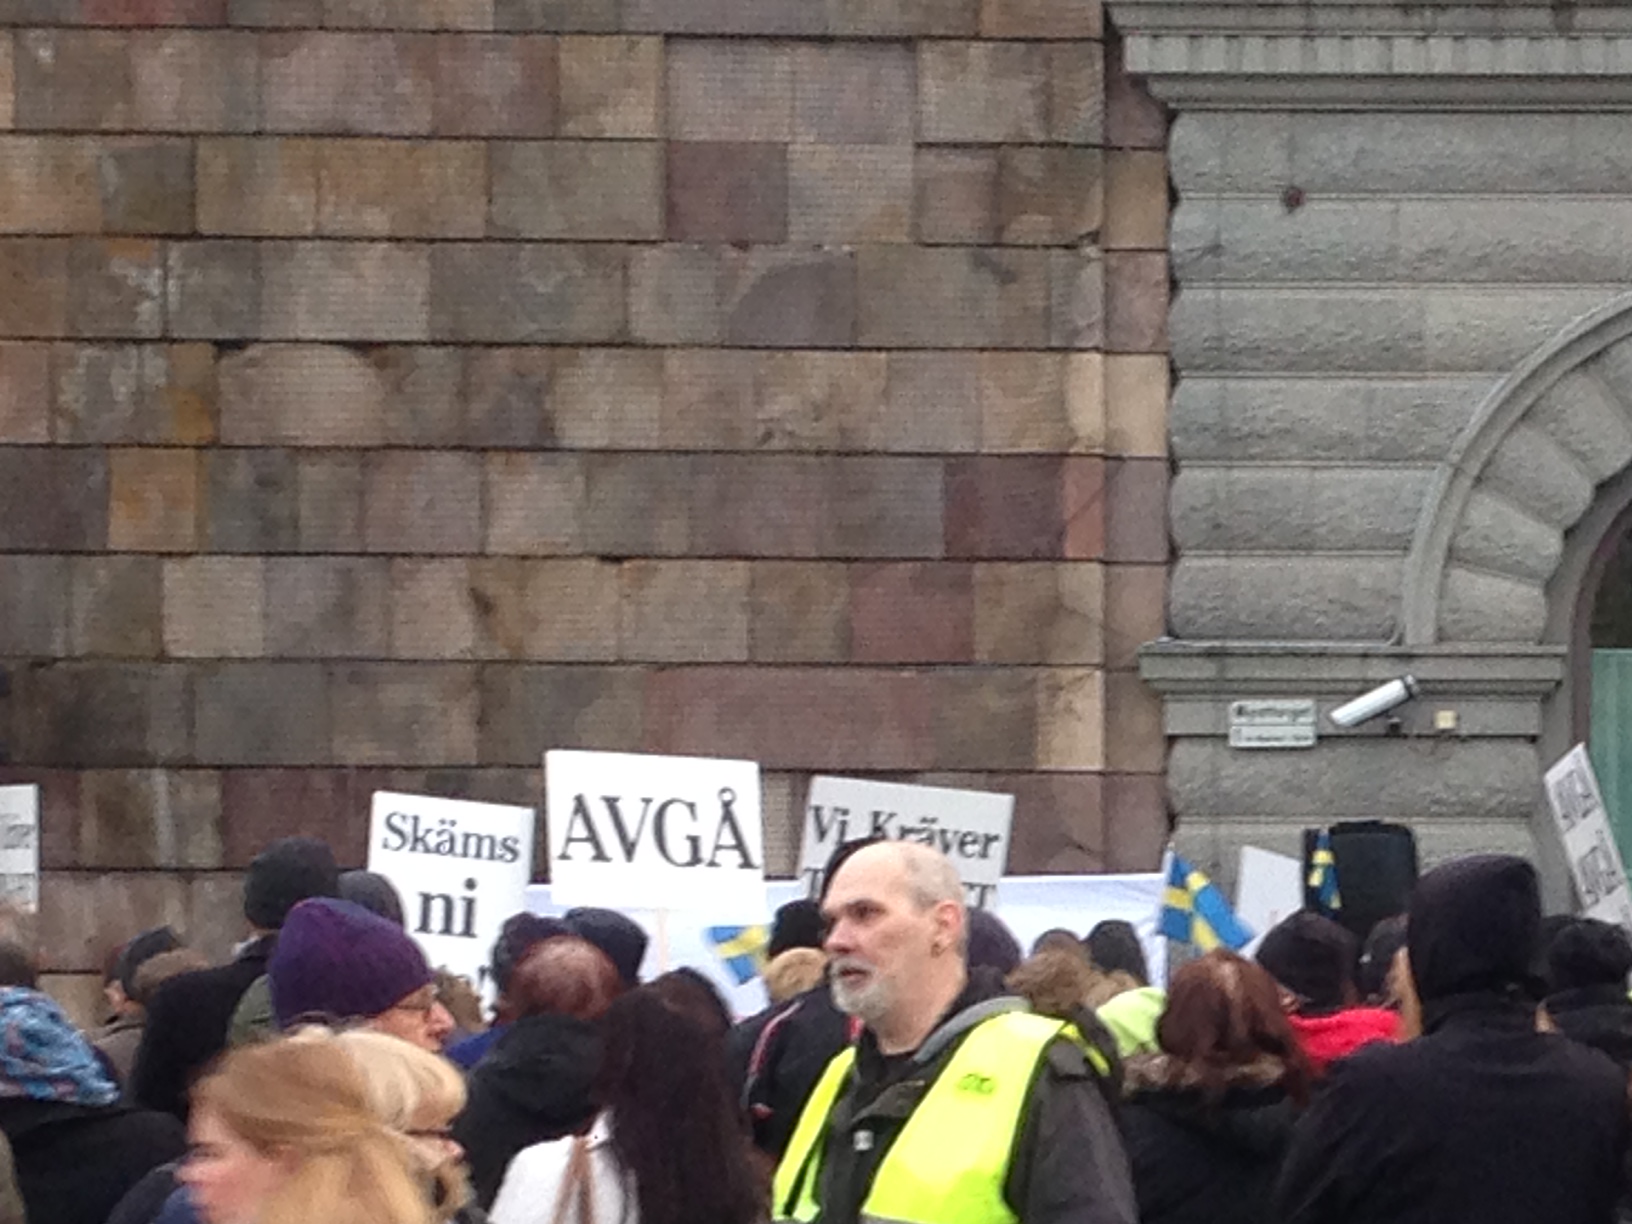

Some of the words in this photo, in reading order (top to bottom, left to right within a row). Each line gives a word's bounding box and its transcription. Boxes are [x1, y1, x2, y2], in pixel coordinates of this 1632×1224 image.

[381, 810, 520, 863] Skäms
[556, 786, 762, 869] AVGÅ
[809, 804, 850, 846] Vi
[869, 810, 999, 859] Kräver
[414, 877, 478, 938] ni
